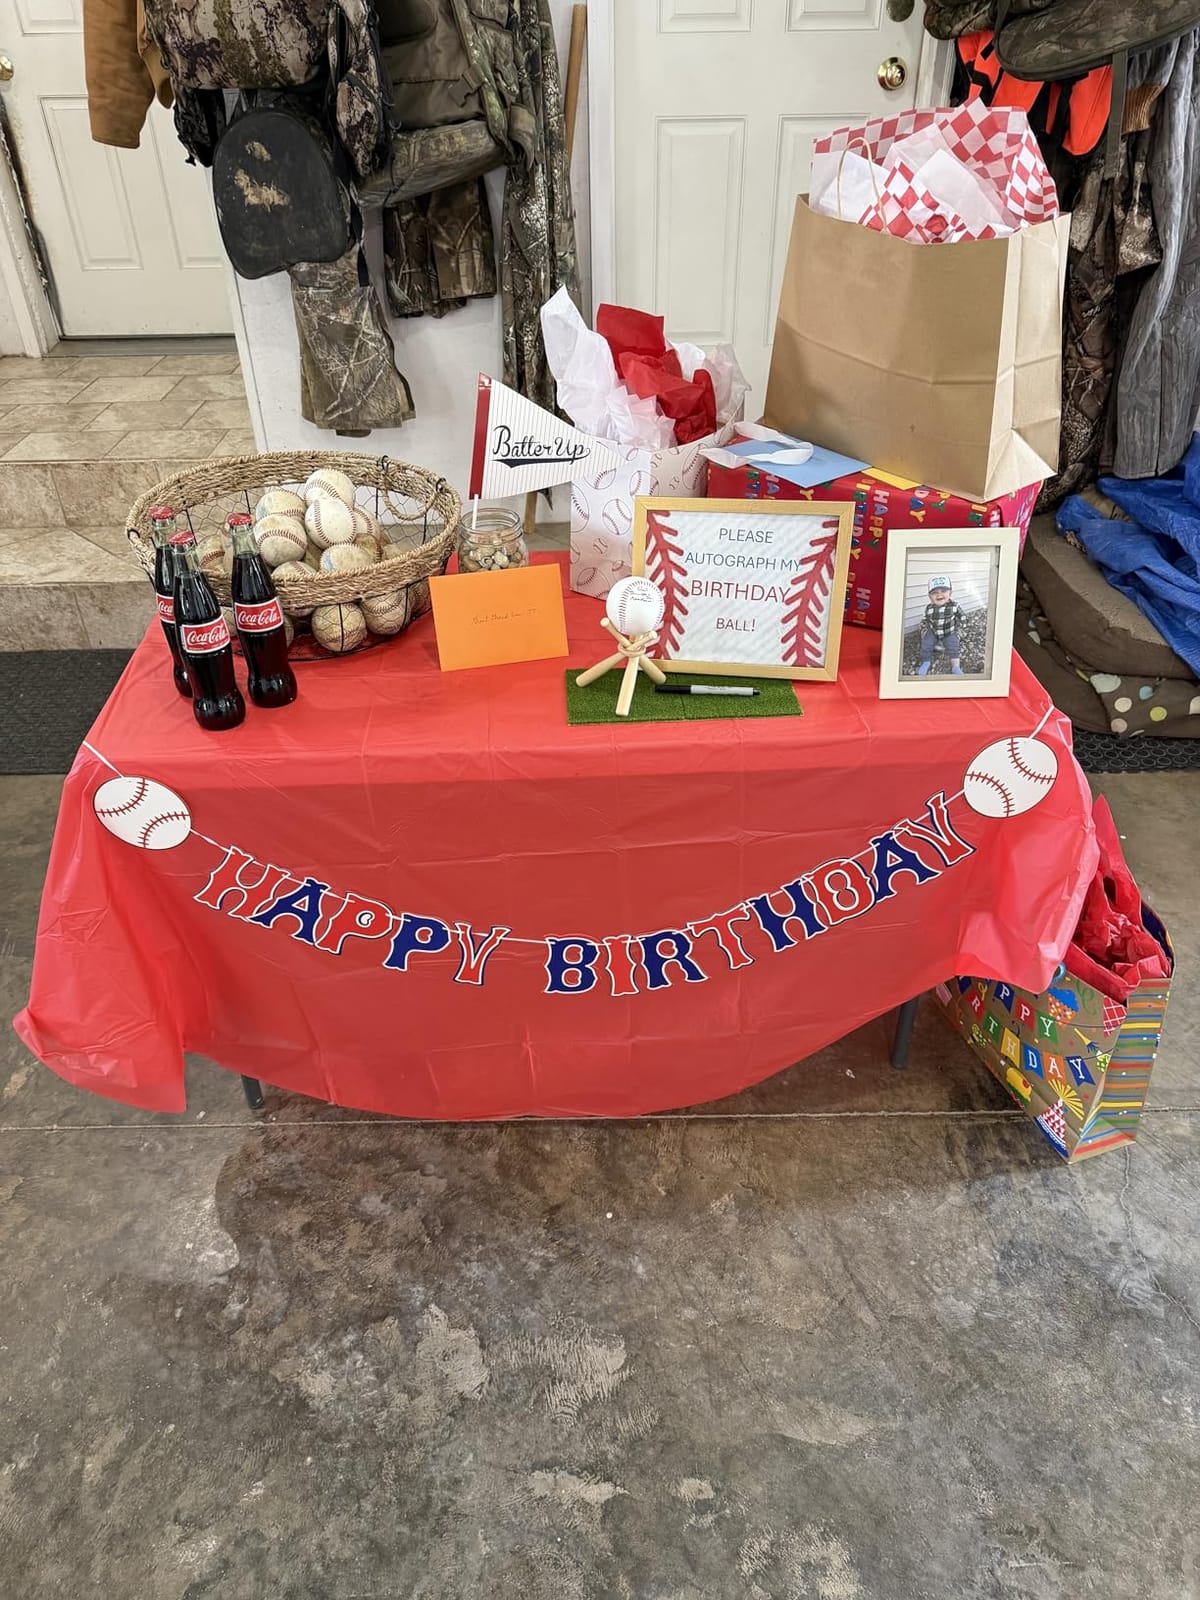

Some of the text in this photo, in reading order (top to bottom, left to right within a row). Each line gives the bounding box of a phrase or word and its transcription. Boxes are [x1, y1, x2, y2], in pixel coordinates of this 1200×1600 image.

[493, 425, 586, 465] Batter Up
[865, 489, 890, 549] HAPPY
[718, 527, 774, 544] PLEASE
[684, 552, 800, 572] AUTOGRAPH MY
[690, 579, 791, 603] BIRTHDAY
[238, 607, 279, 626] Coca-Cola
[716, 617, 756, 632] BALL!
[186, 623, 227, 646] Coca-Cola
[193, 791, 976, 996] HAPPY BIRTHDAY
[969, 990, 1085, 1080] RTHDAY
